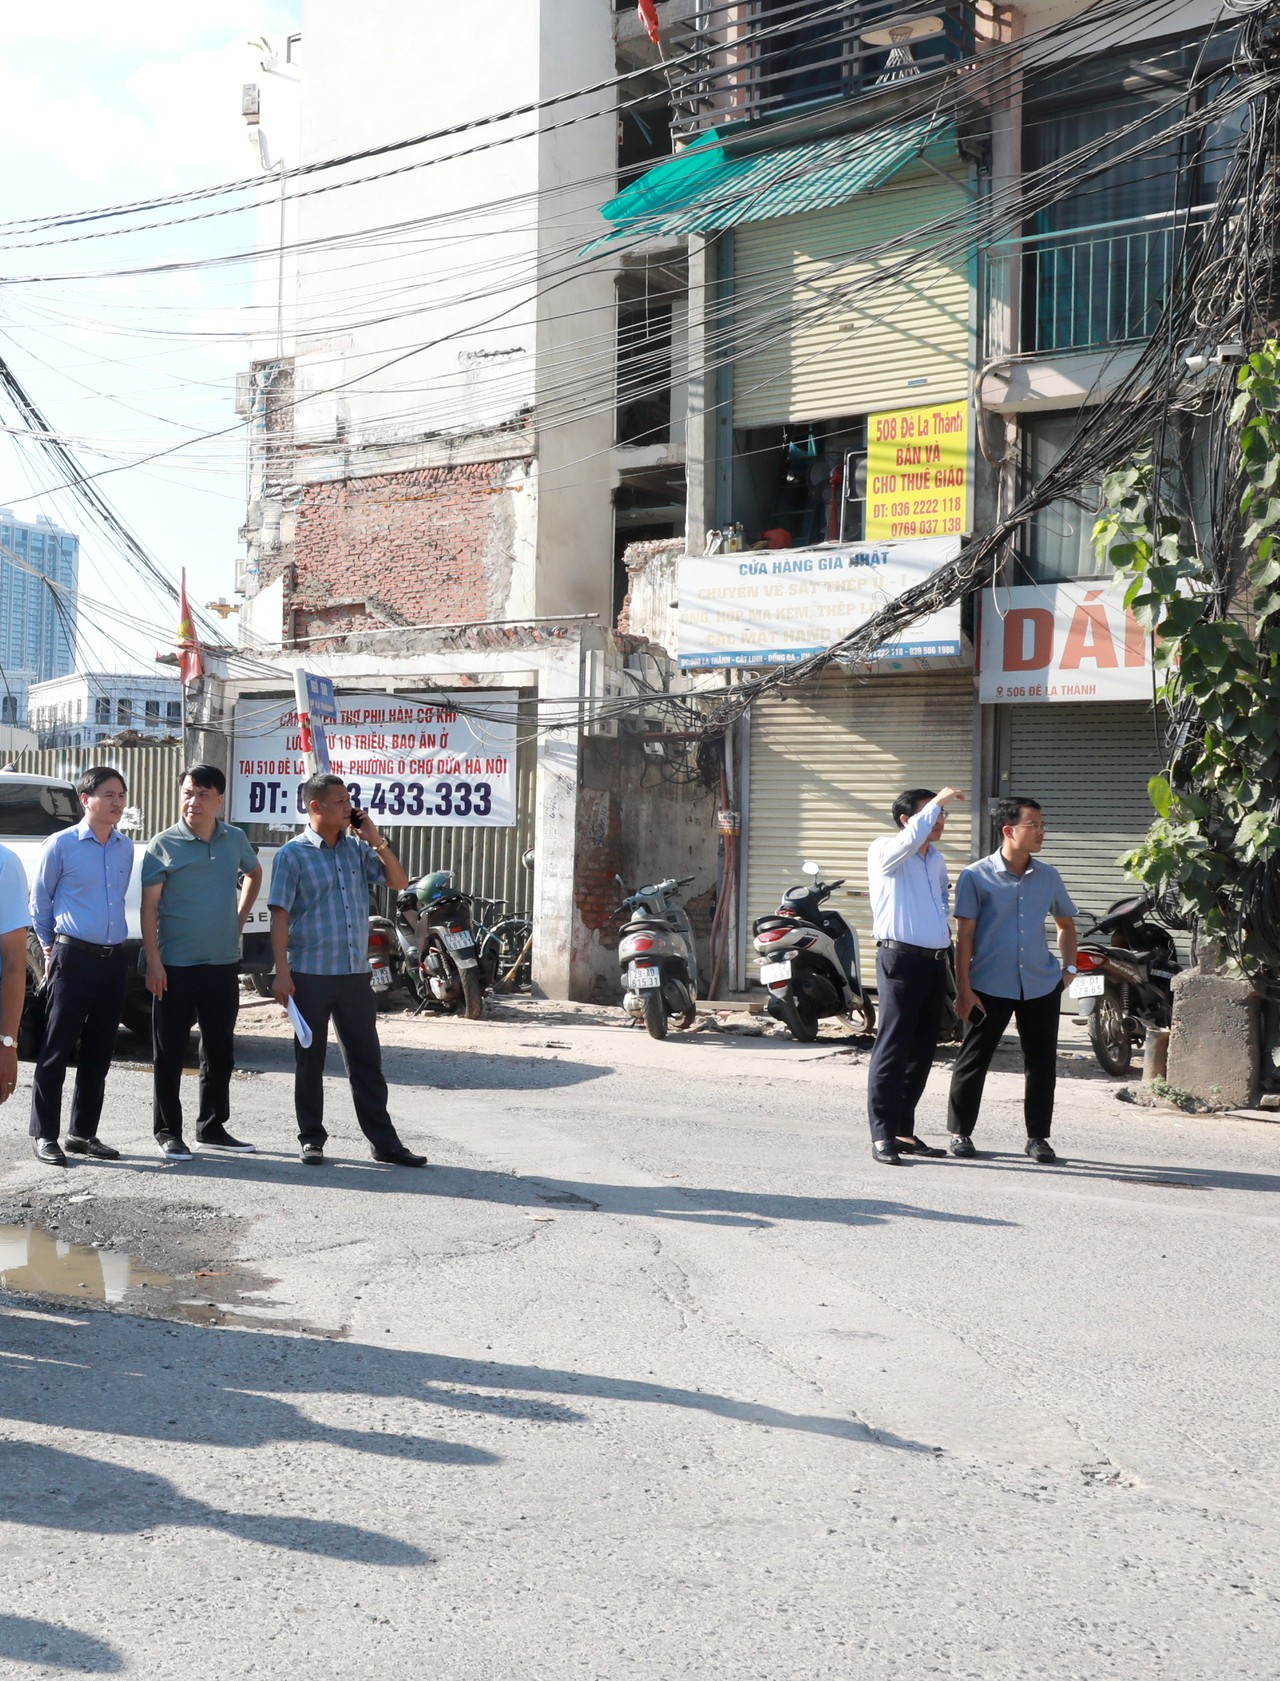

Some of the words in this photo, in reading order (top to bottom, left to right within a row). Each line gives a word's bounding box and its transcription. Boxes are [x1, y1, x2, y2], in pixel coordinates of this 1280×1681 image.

[876, 417, 897, 442] 508
[901, 415, 915, 439] Đê
[918, 414, 929, 437] La
[896, 443, 922, 466] BÁN
[925, 440, 941, 463] VÀ
[873, 474, 897, 495] CHO
[901, 467, 931, 492] THUÊ
[935, 464, 964, 489] GIÁO
[873, 503, 889, 519] ĐT:
[891, 501, 910, 517] 036
[913, 498, 939, 515] 2222
[942, 496, 961, 513] 118
[891, 521, 917, 537] 0769
[919, 519, 939, 535] 037
[942, 517, 961, 533] 138
[739, 559, 768, 576] CỬA
[772, 558, 813, 575] HÀNG
[818, 556, 844, 571] GIA
[1007, 686, 1026, 698] 506
[1028, 684, 1042, 697] ĐÊ
[1045, 685, 1058, 696] LA
[1061, 683, 1097, 696] THÀNH
[363, 709, 385, 728] PHỤ
[339, 735, 351, 750] 10
[392, 733, 416, 750] BAO
[420, 730, 436, 749] ĂN
[440, 727, 449, 749] Ở
[239, 760, 254, 778] TẠI
[257, 760, 275, 775] 510
[278, 757, 291, 775] ĐÊ
[350, 755, 394, 776] PHƯỜNG
[398, 756, 406, 775] Ô
[409, 758, 435, 778] CHỢ
[465, 755, 482, 775] HÀ
[485, 755, 507, 778] NỘI
[249, 782, 288, 814] ĐT:
[297, 782, 491, 816] 03.433.333
